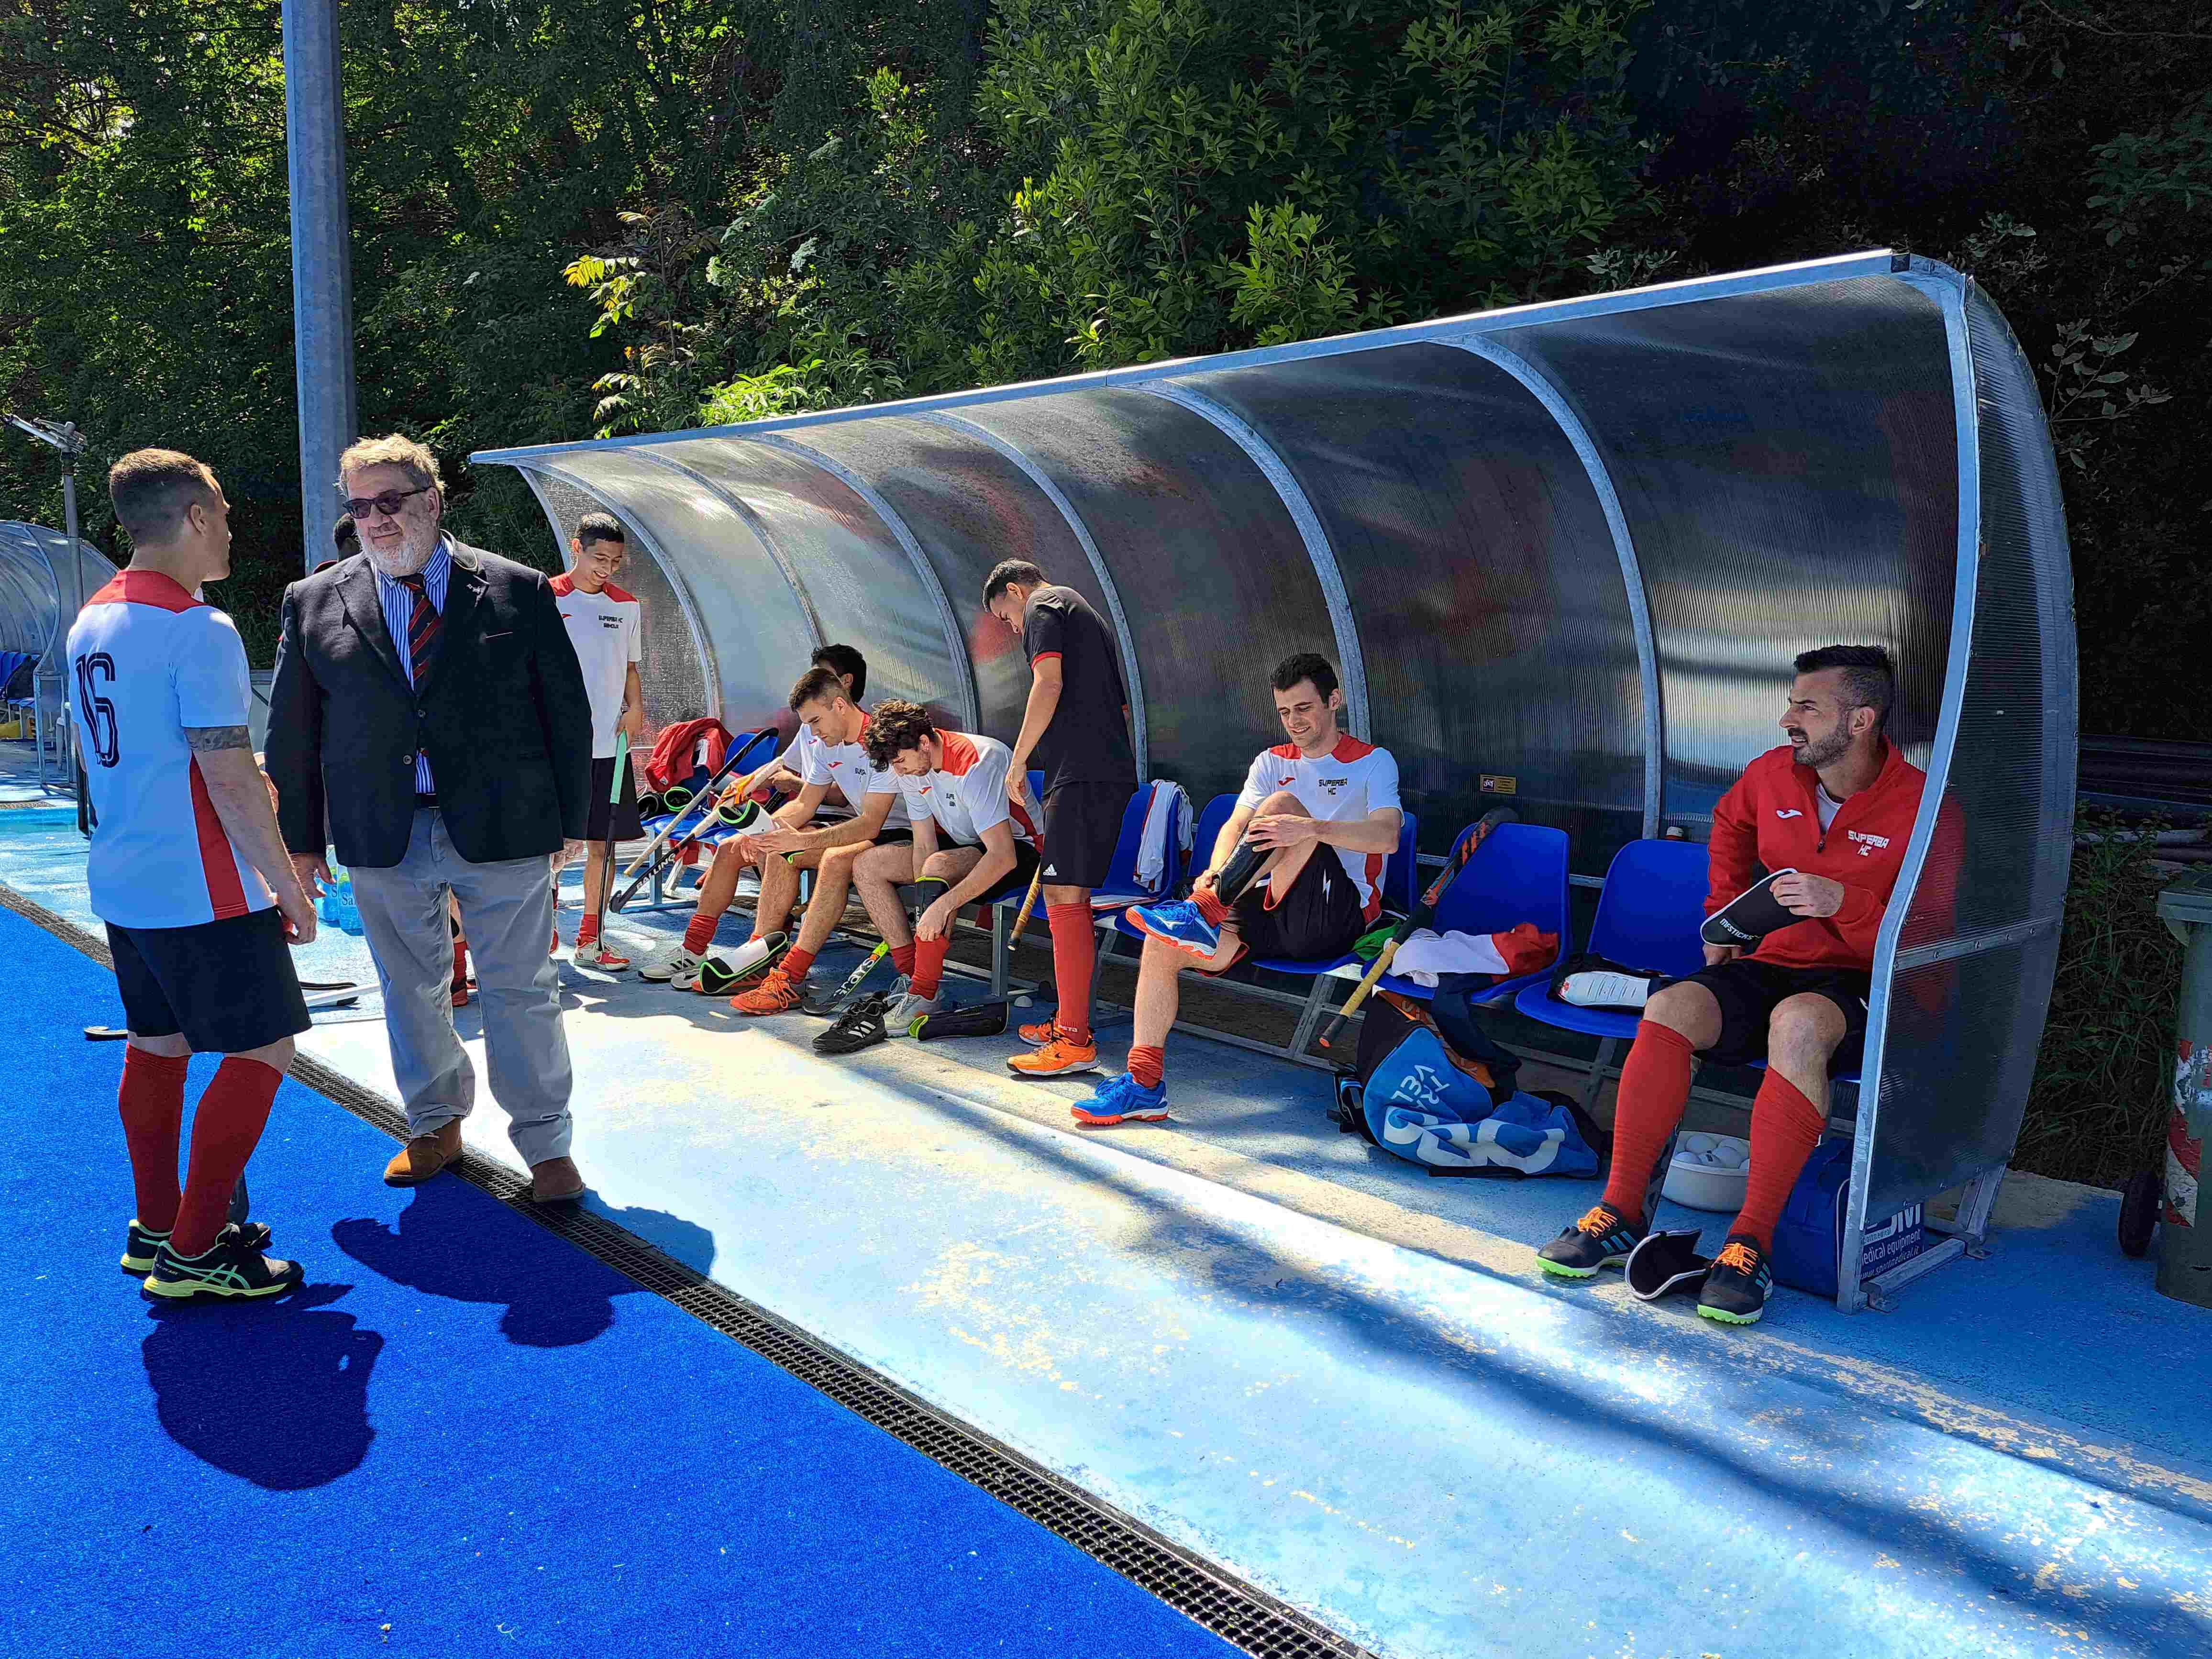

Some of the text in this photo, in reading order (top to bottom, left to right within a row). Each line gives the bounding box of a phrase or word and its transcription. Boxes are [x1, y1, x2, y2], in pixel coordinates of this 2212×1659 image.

[76, 652, 121, 768] 16
[1327, 787, 1337, 796] HC
[1848, 830, 1890, 849] SUPERBA
[1857, 844, 1872, 857] HC
[1887, 1228, 1921, 1255] equipment
